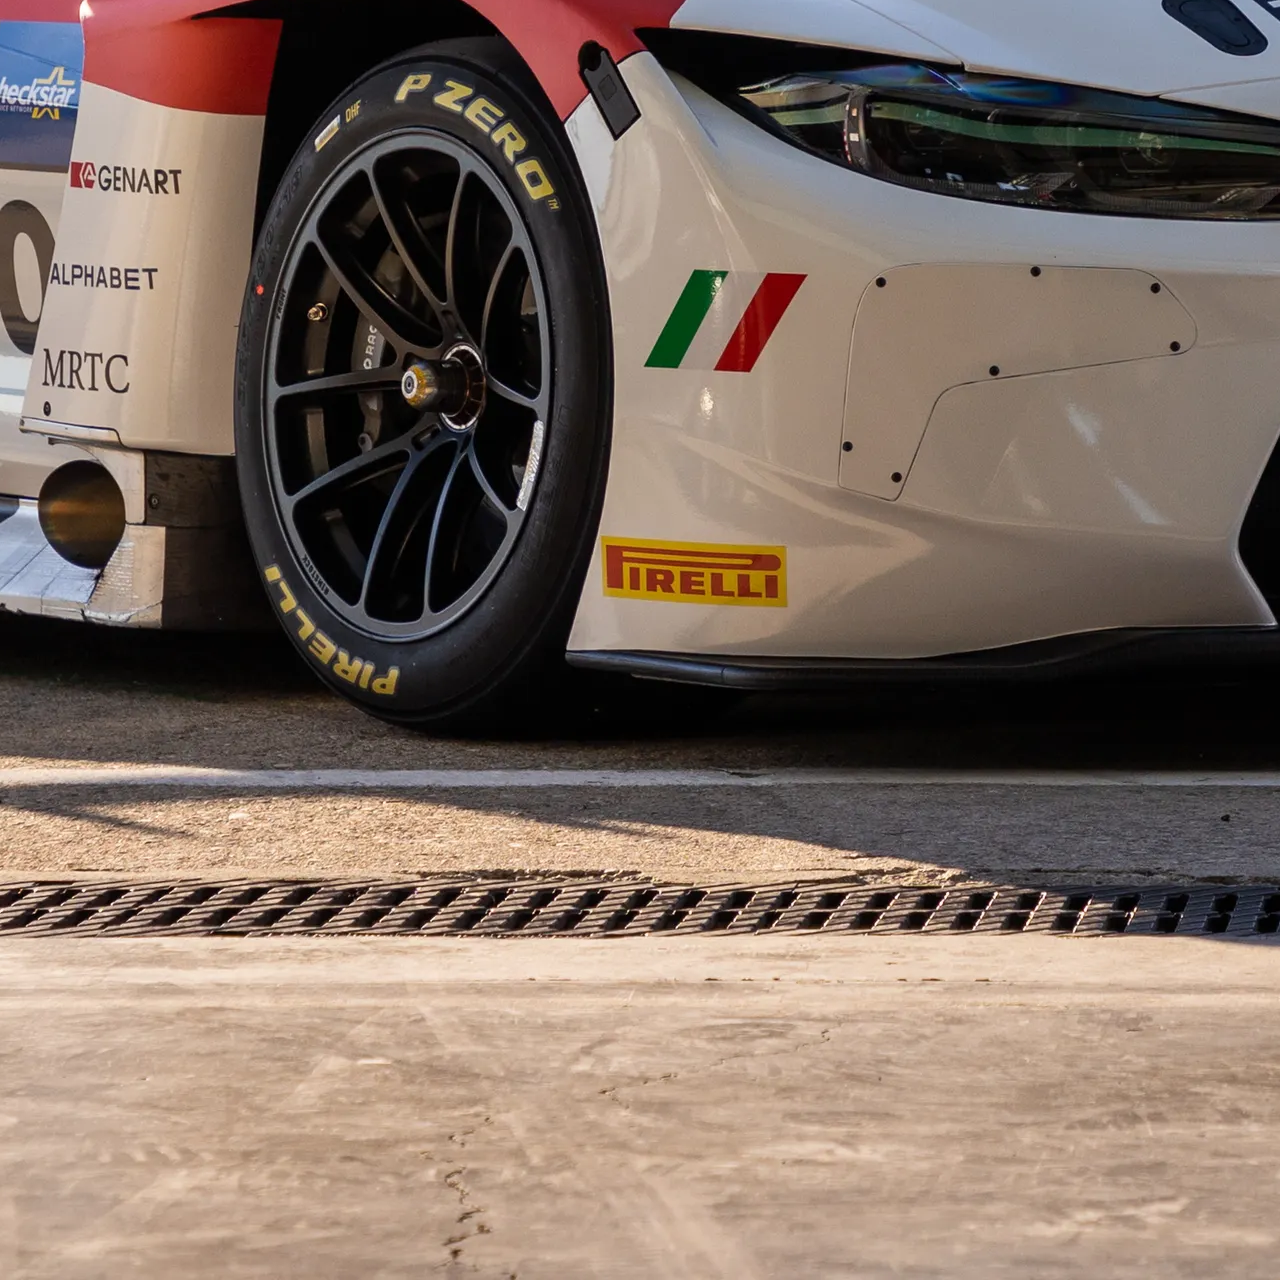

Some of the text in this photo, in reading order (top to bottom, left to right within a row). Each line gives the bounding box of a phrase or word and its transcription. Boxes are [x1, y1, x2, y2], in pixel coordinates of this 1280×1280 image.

[394, 74, 432, 103] P
[433, 80, 555, 201] ZERO
[98, 164, 182, 195] GENART
[50, 263, 158, 291] ALPHABET
[42, 348, 131, 394] MRTC
[605, 544, 782, 599] PIRELLI
[264, 565, 401, 696] PIRELLI
